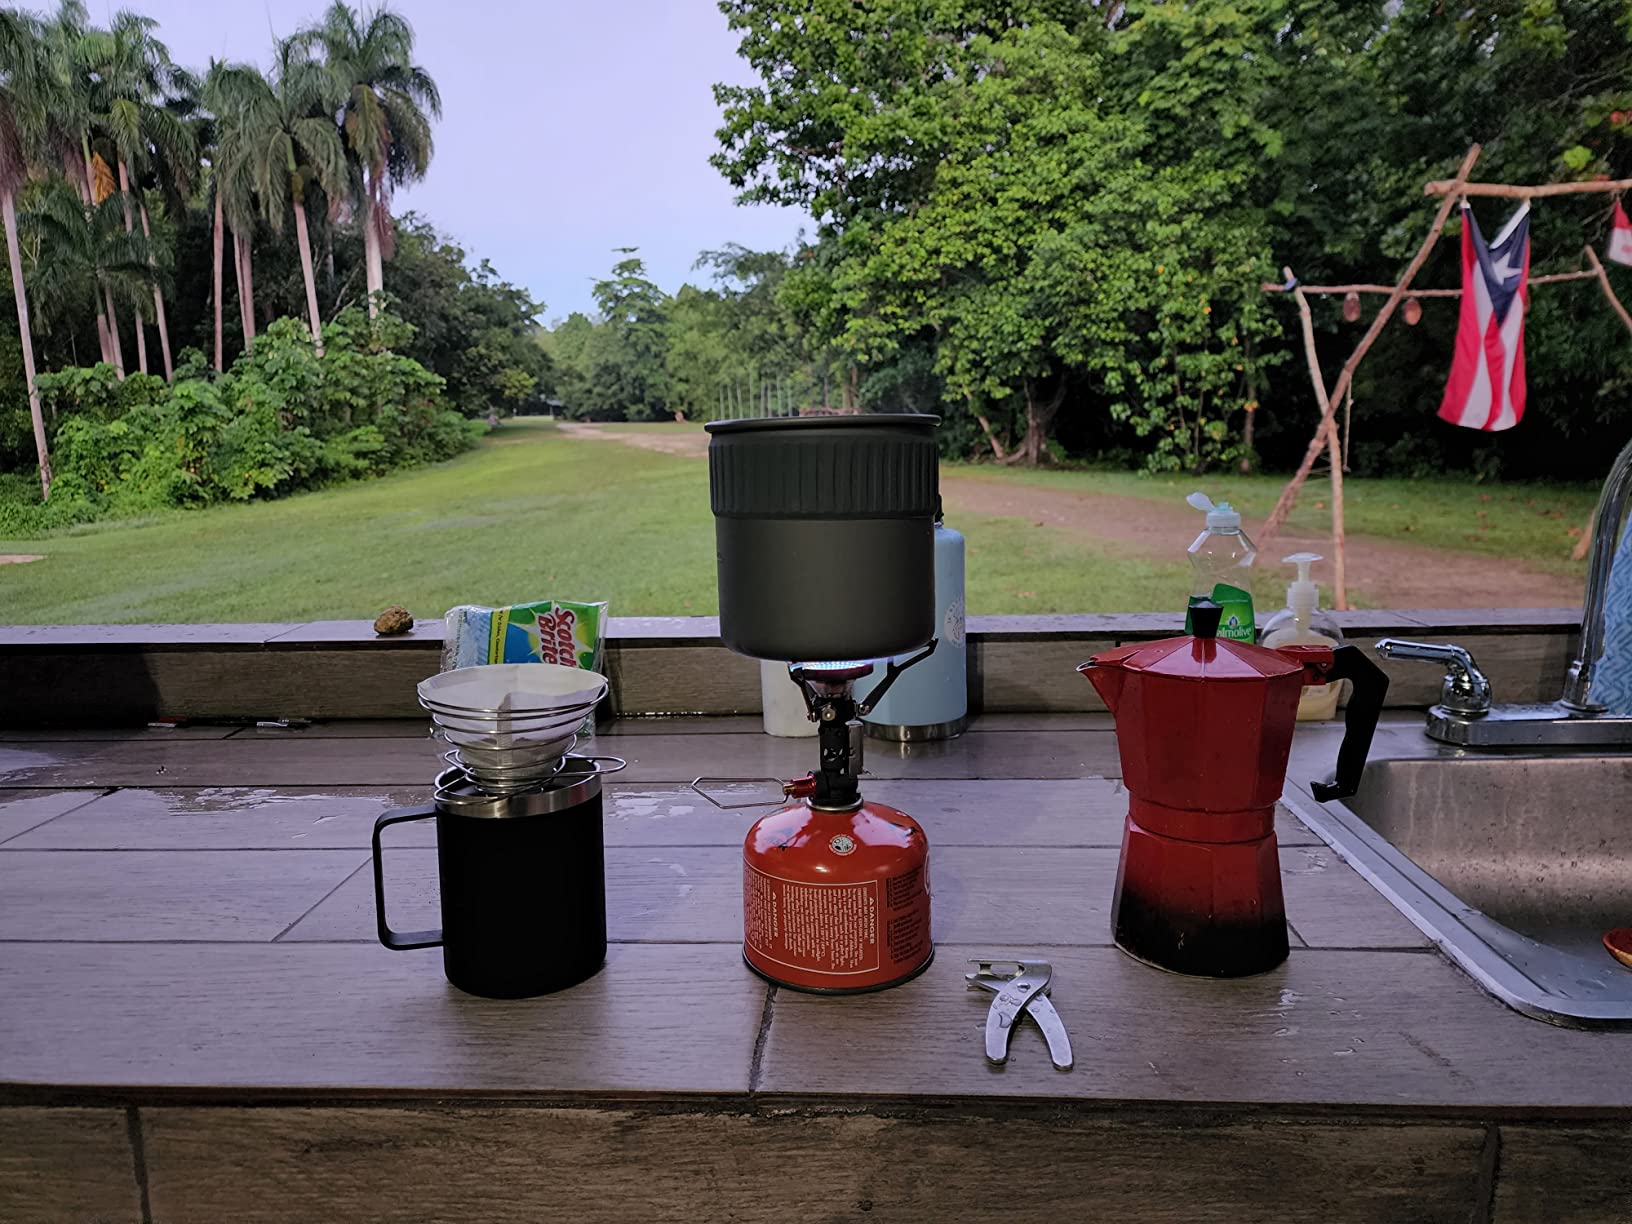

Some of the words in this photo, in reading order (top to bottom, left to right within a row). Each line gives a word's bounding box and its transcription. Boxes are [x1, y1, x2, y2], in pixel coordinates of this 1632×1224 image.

[538, 613, 558, 664] Brite
[555, 607, 577, 667] Scotch
[1217, 626, 1251, 639] almolive
